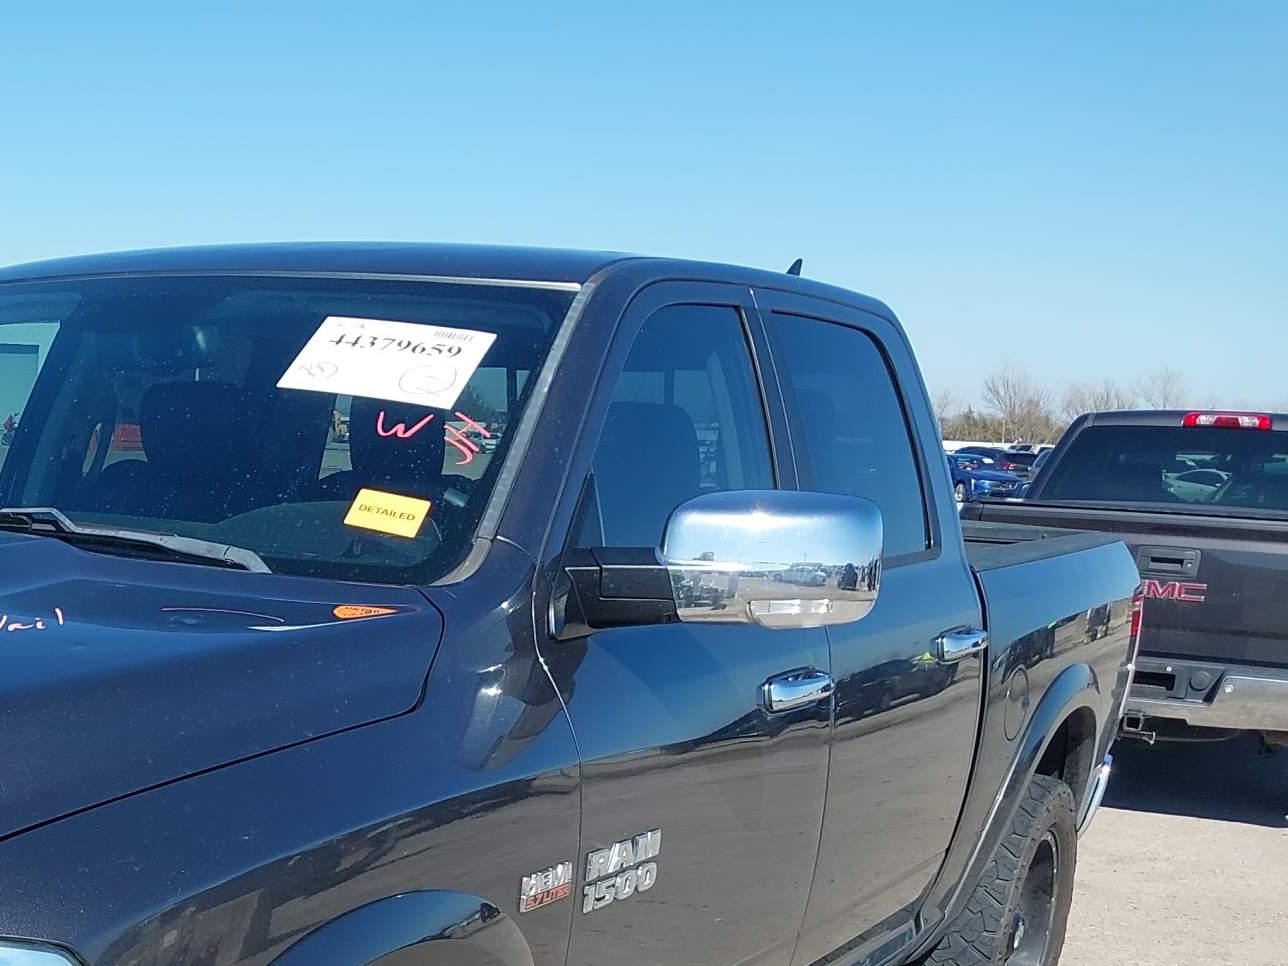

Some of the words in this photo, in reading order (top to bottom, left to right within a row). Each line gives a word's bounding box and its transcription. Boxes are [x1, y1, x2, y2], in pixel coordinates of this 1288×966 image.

[329, 333, 462, 357] 44379659
[358, 503, 416, 521] DETAILED
[1141, 579, 1207, 601] MC
[585, 828, 662, 881] RAM
[582, 862, 658, 914] 1500
